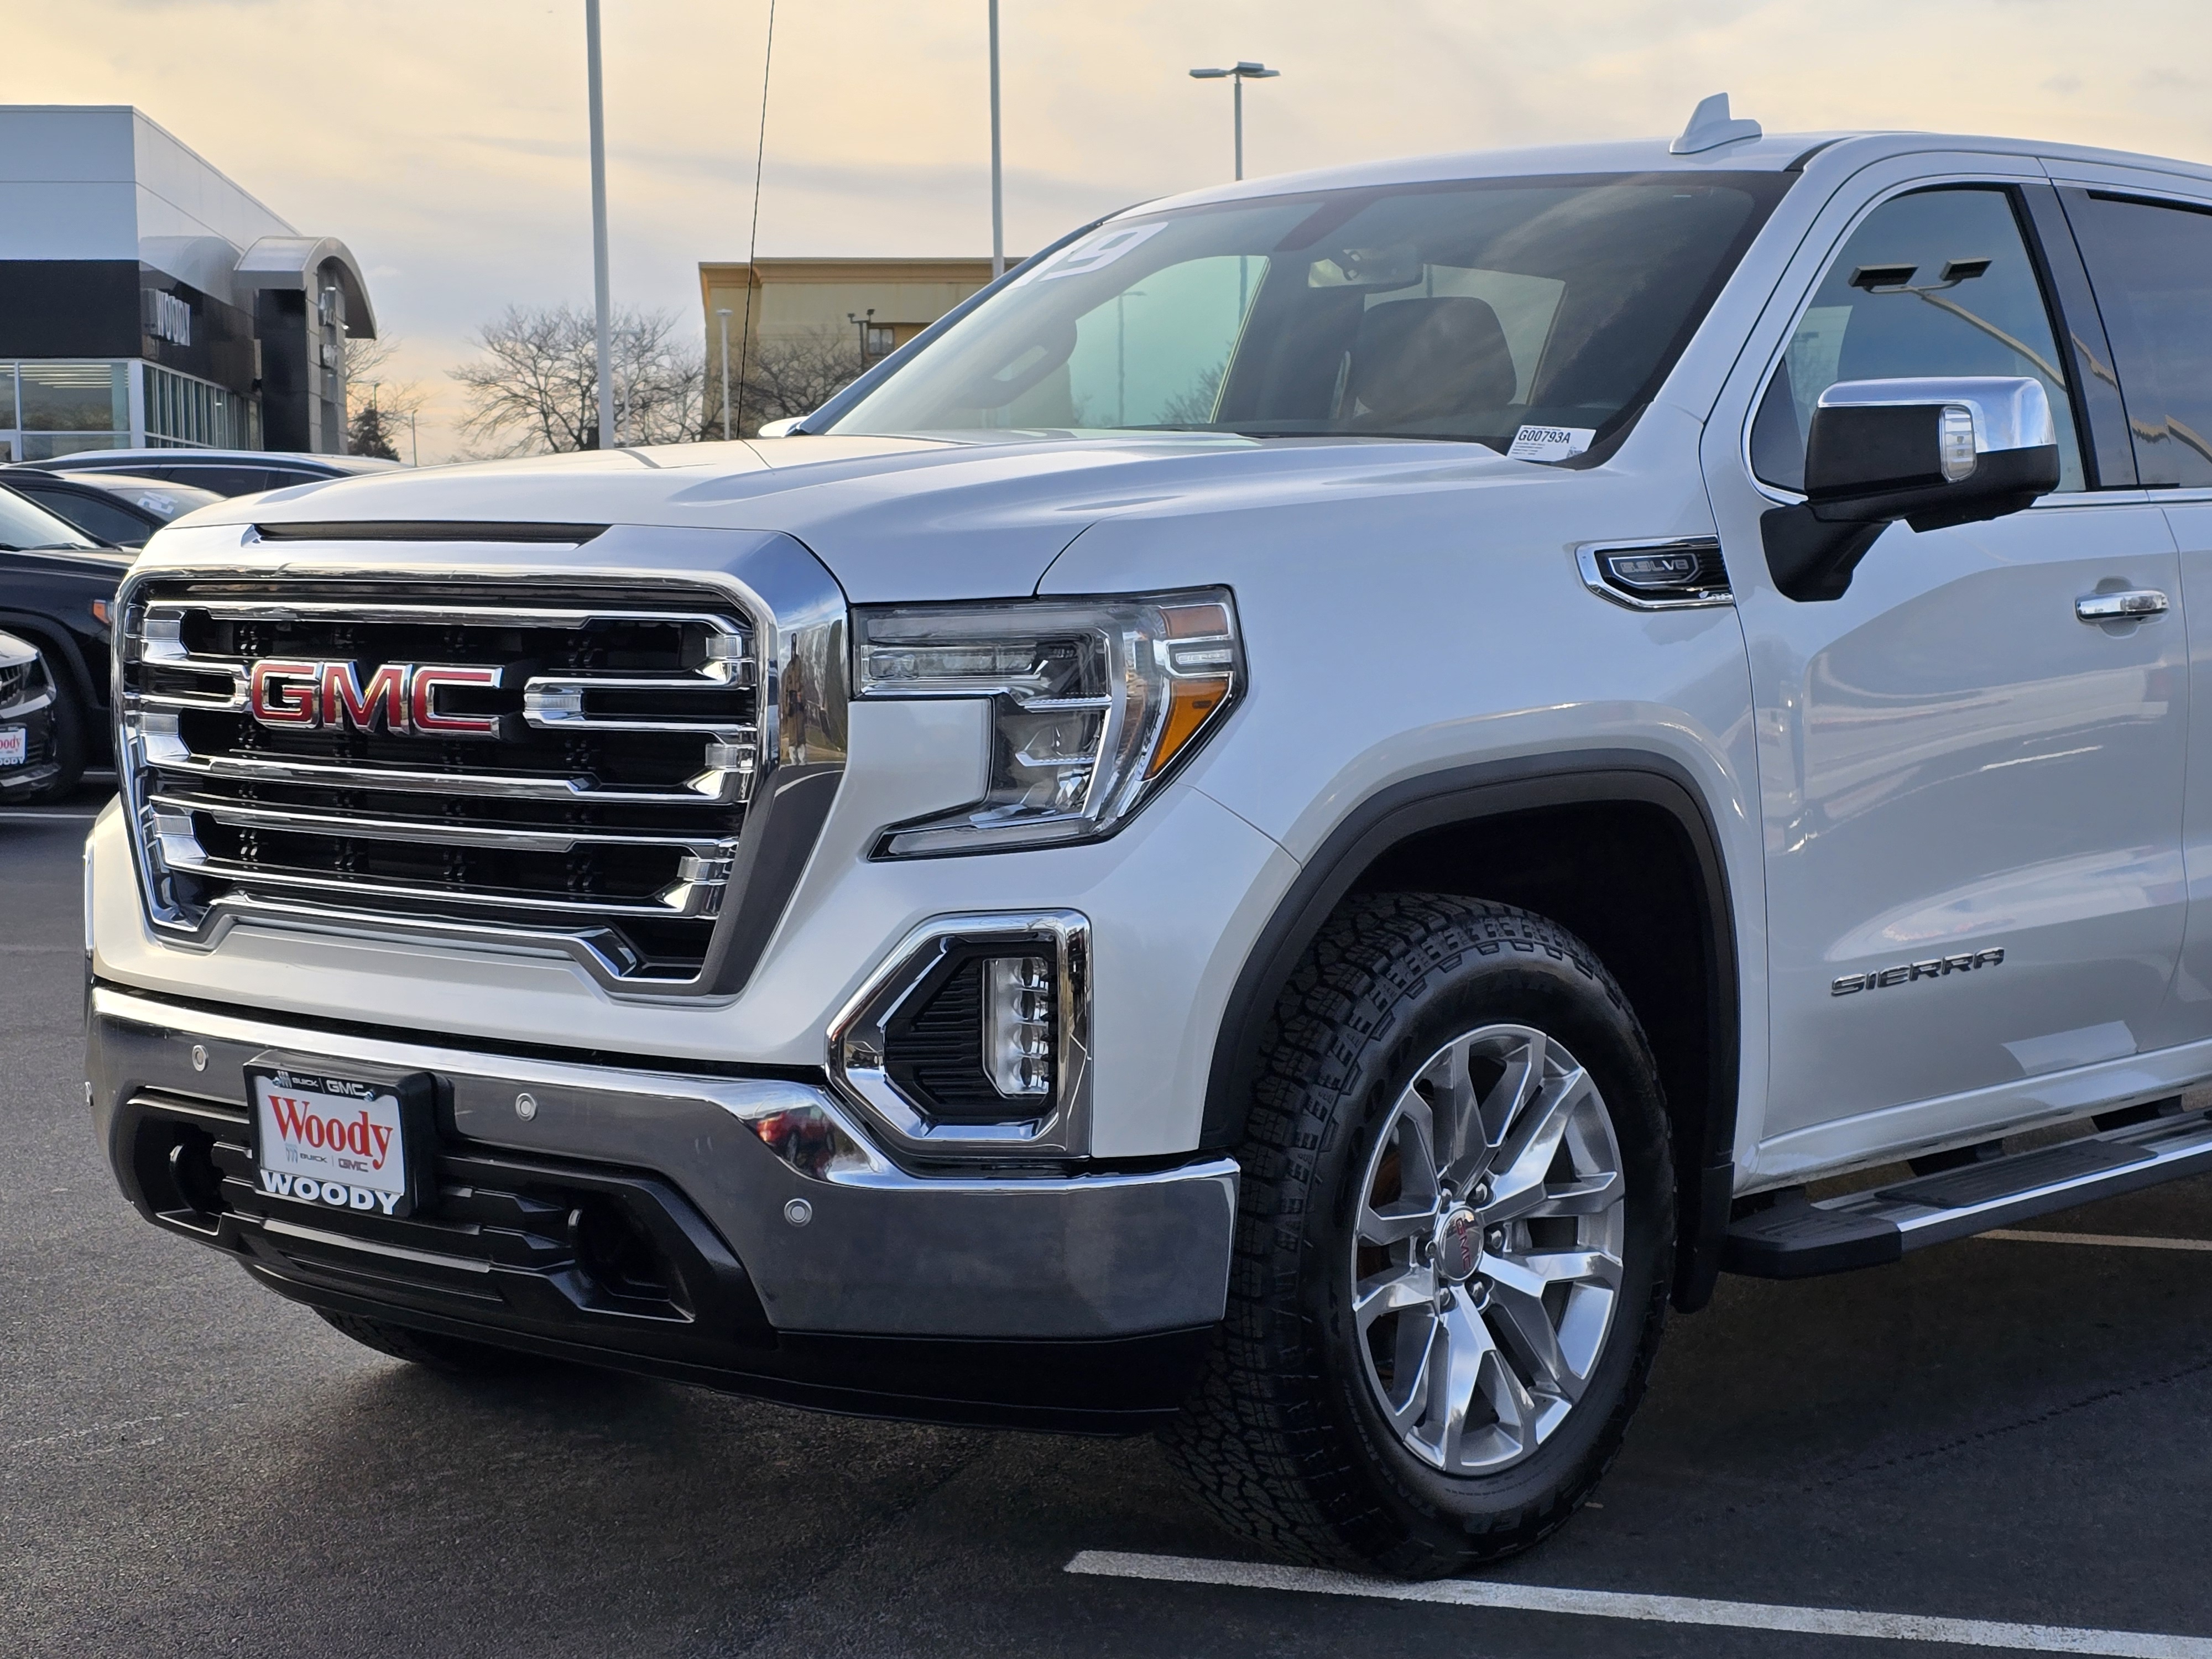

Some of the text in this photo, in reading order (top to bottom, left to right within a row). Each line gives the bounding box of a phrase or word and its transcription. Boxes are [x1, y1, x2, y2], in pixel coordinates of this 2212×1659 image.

[1518, 430, 1571, 444] G00793A
[138, 491, 178, 514] 24
[251, 659, 504, 739] GMC
[1831, 946, 2005, 997] SIERRA
[292, 1077, 365, 1096] BUICK GMC
[268, 1094, 393, 1170] Woody
[299, 1152, 369, 1172] BUICK GMC
[260, 1170, 401, 1215] WOODY
[1455, 1217, 1471, 1271] GMC
